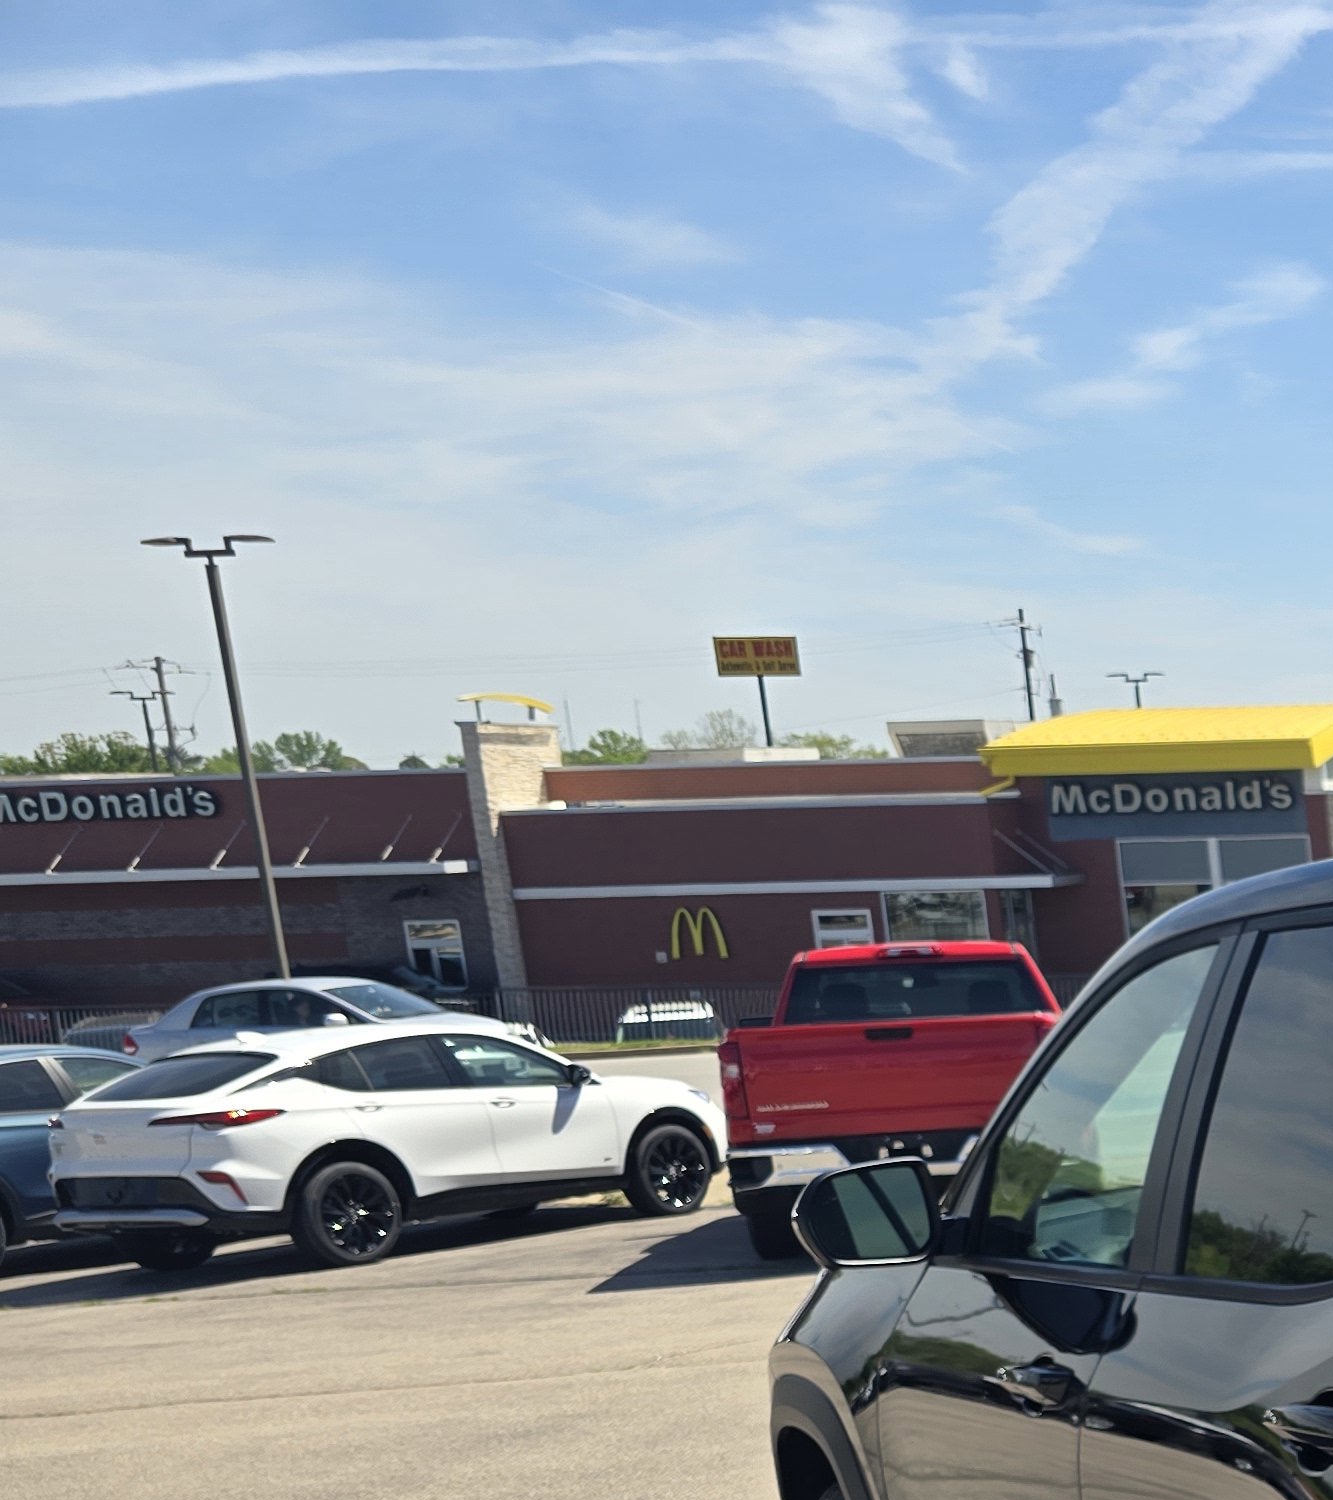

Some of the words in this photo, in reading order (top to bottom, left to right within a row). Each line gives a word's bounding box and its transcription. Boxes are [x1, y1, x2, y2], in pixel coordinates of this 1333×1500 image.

[719, 640, 747, 658] CAR
[752, 640, 793, 657] WASH
[1051, 779, 1293, 814] McDonald's
